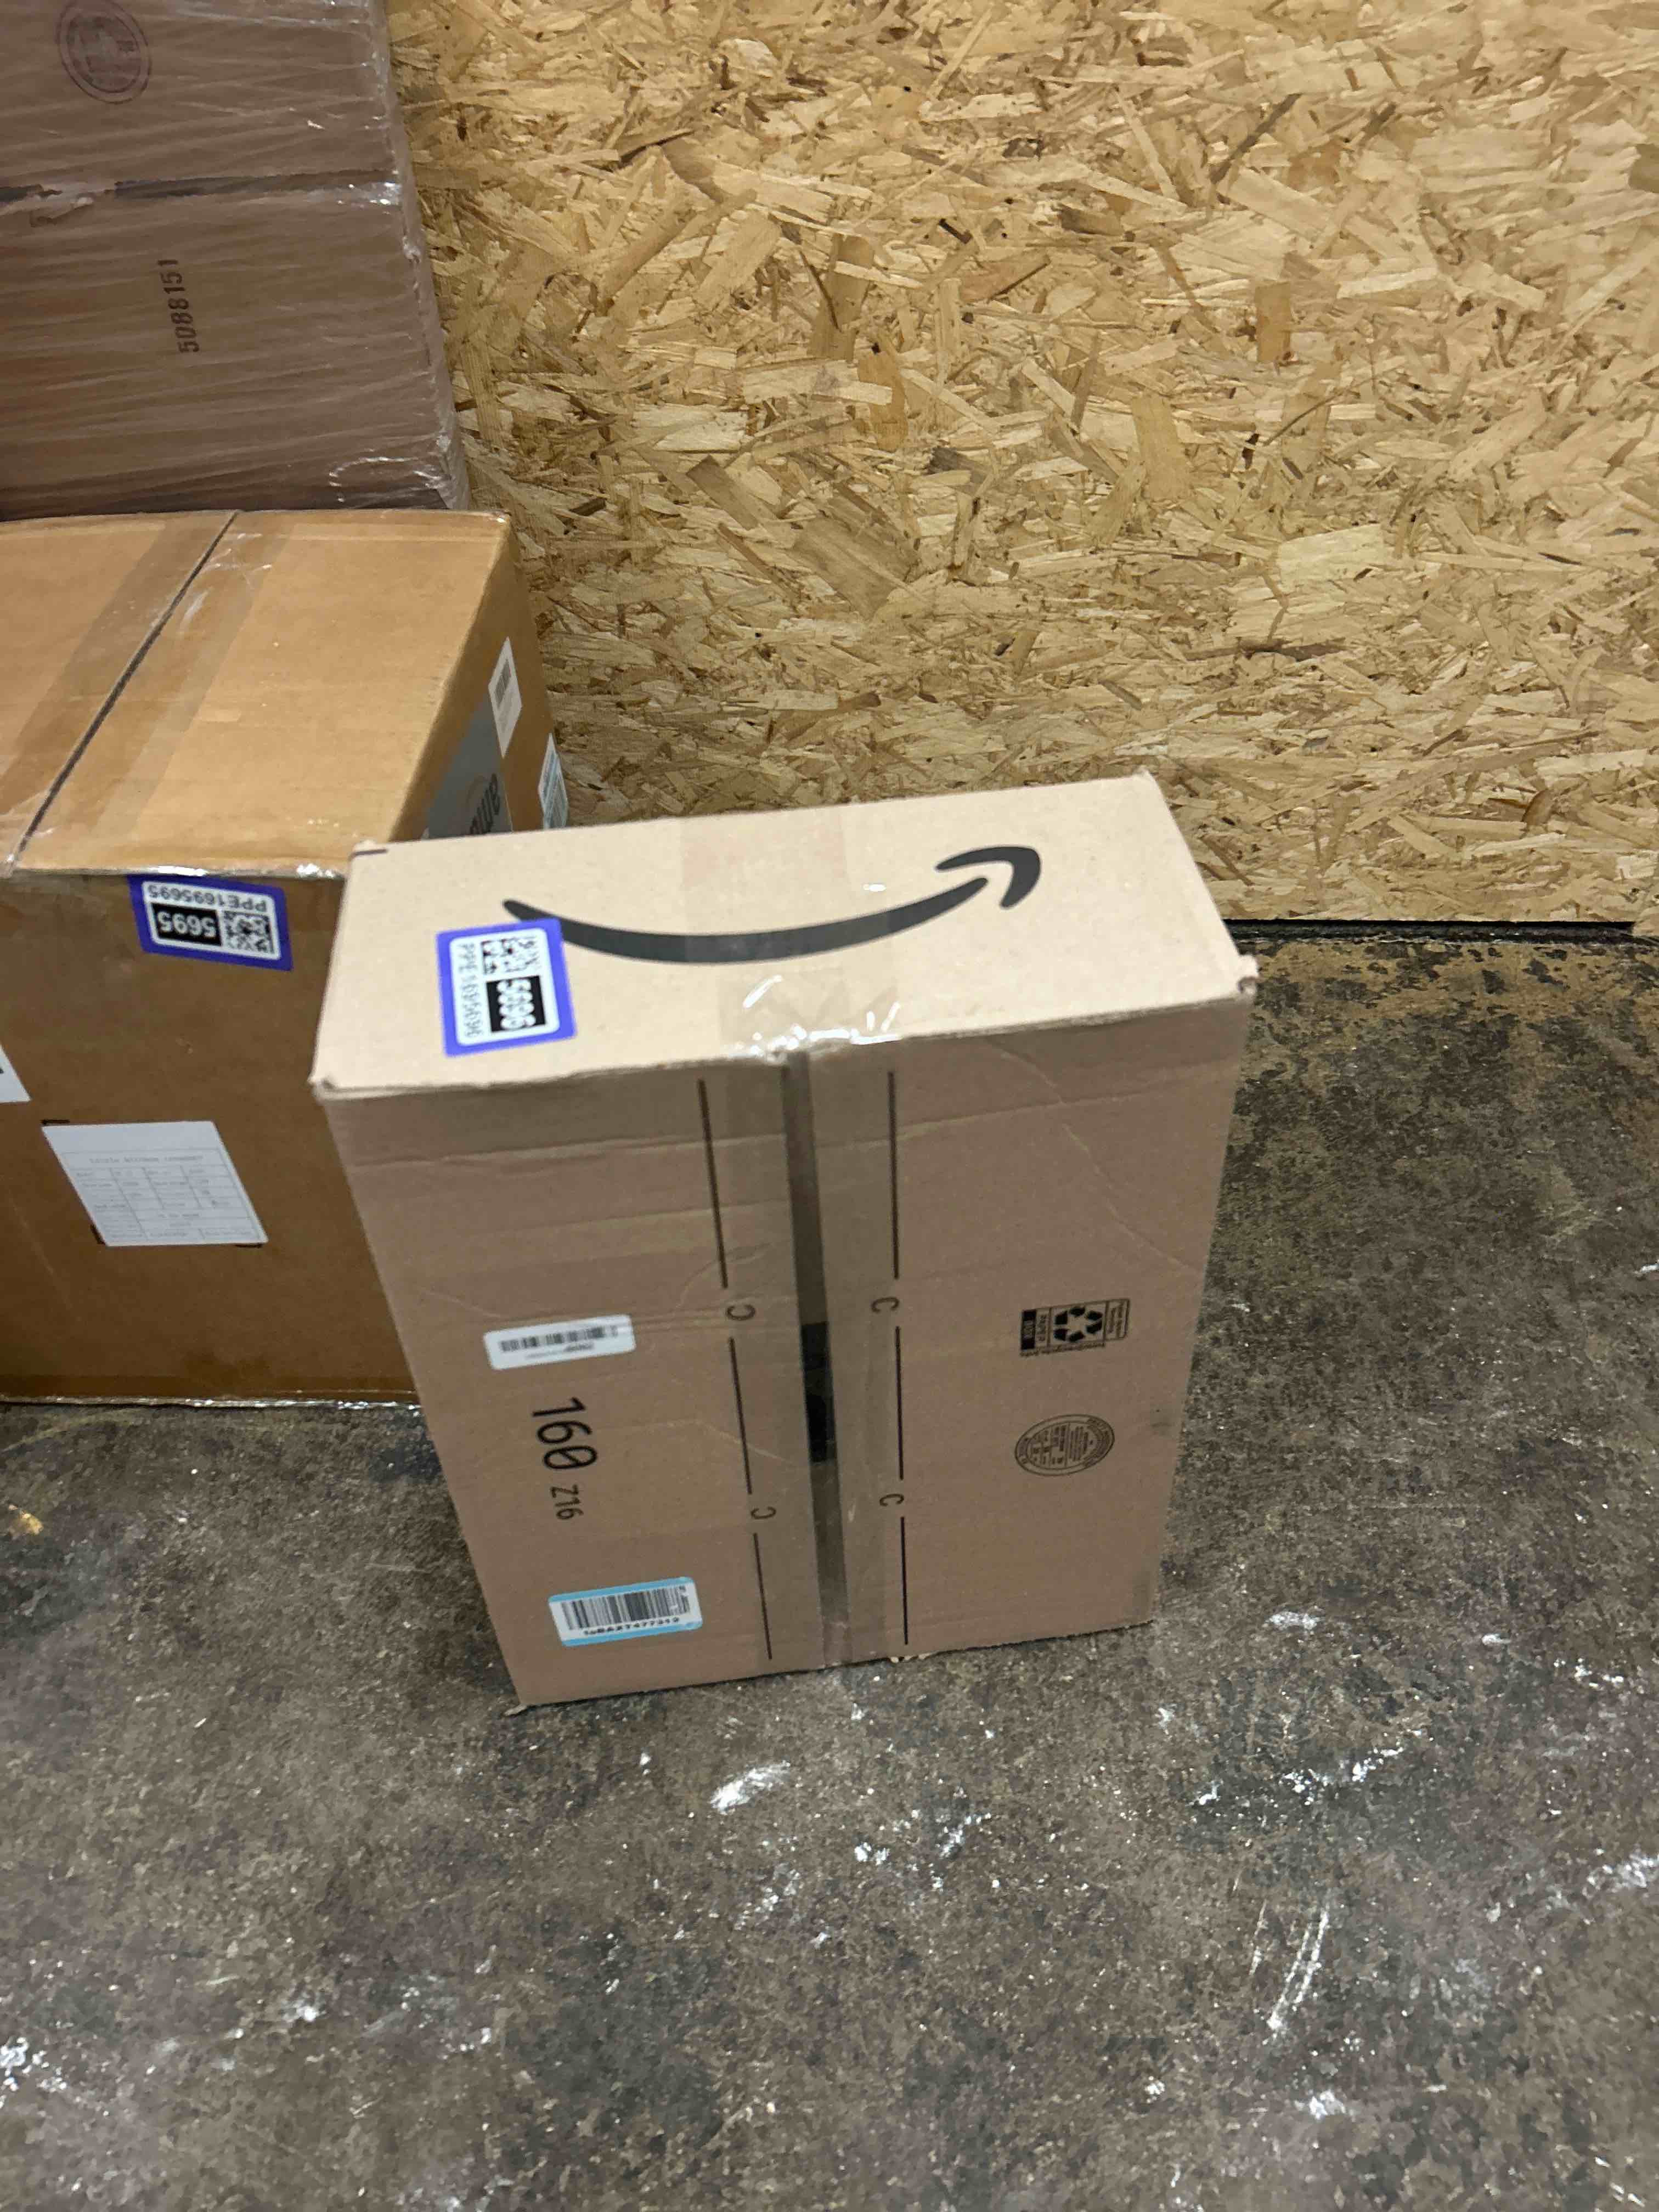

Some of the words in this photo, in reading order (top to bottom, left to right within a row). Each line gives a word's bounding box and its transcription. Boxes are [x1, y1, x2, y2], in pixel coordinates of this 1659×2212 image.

[157, 259, 200, 354] 5088151
[148, 884, 267, 913] PPE1695695
[157, 911, 217, 938] 5695
[532, 1396, 599, 1470] 160
